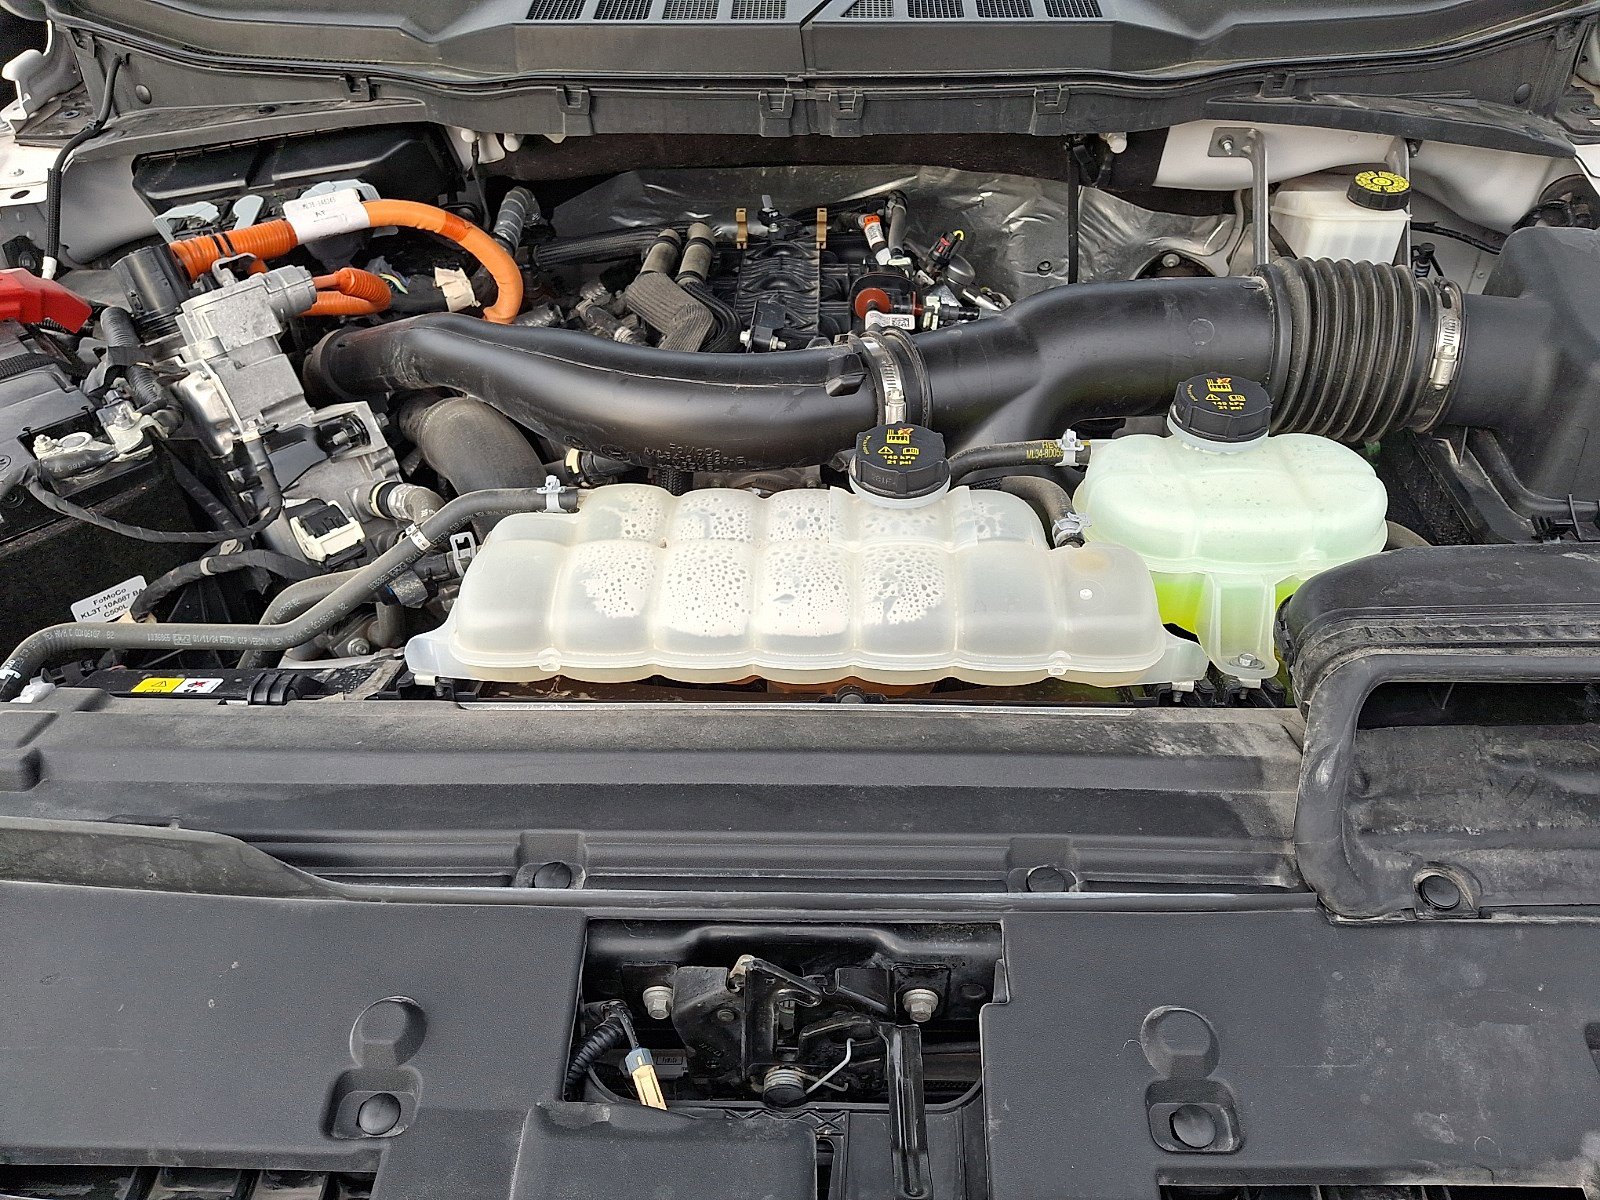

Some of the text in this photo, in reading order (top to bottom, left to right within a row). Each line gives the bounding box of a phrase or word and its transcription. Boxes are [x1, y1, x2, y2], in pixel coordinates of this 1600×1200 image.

[93, 588, 127, 606] FoMoCo
[80, 607, 102, 620] KL3T
[103, 604, 129, 618] C500L
